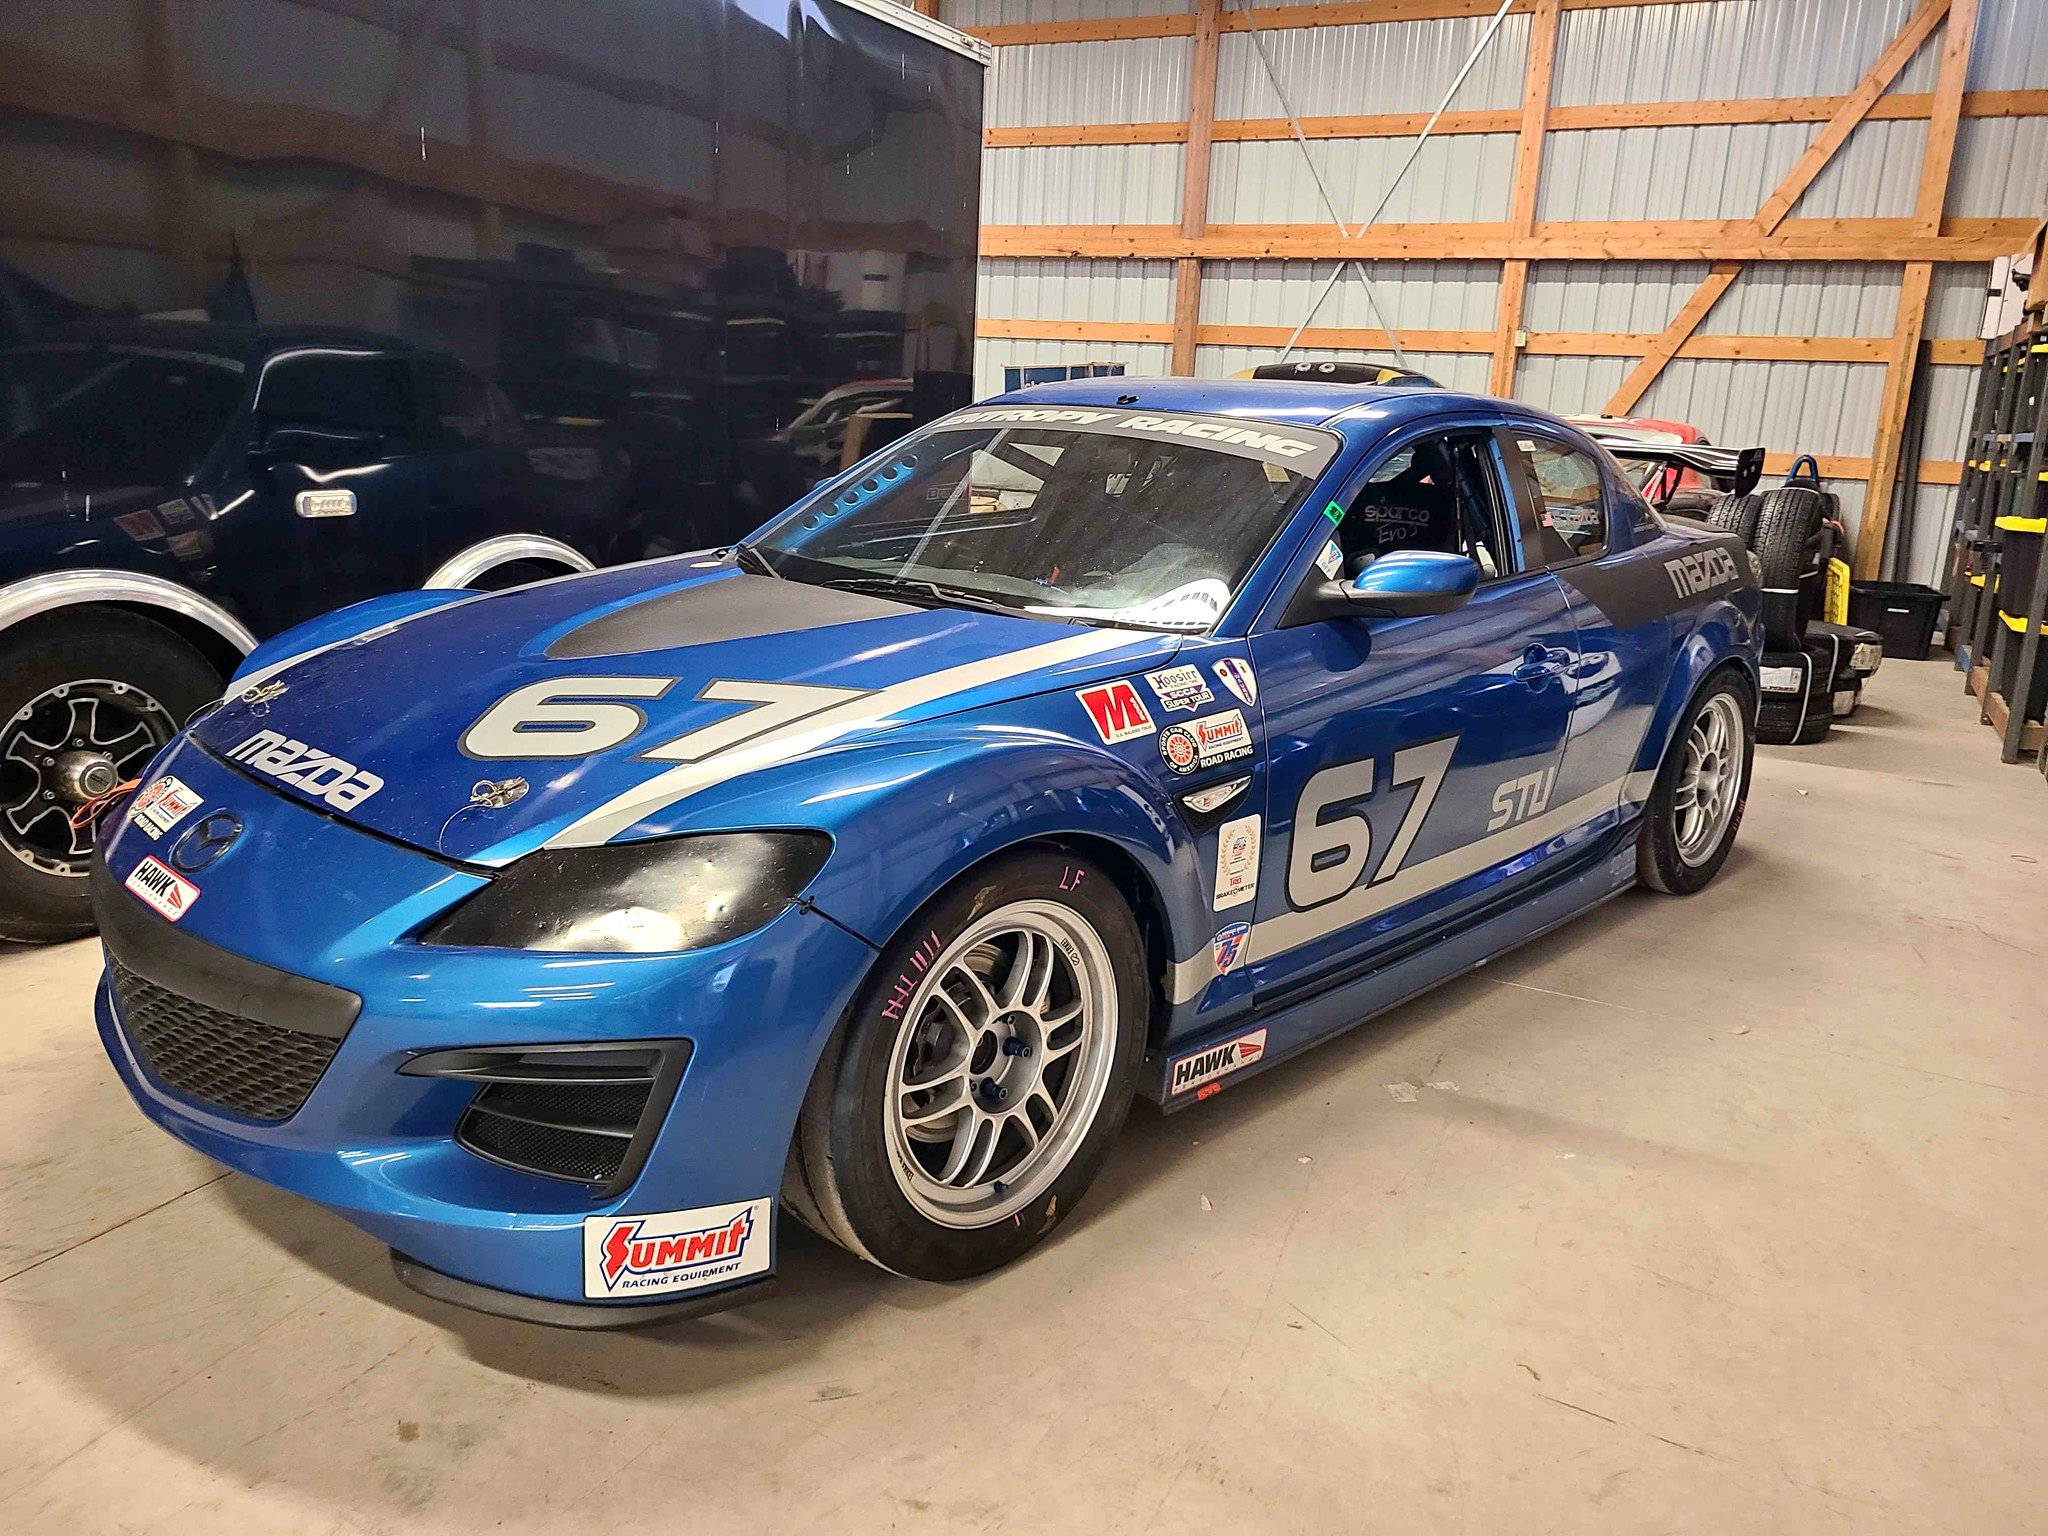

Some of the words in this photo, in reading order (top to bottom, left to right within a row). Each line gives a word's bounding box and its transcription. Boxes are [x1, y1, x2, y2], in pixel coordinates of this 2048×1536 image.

[1116, 416, 1319, 458] RACING
[1363, 504, 1430, 525] sparco
[1152, 669, 1198, 690] Hoosier
[1169, 686, 1198, 699] SCCA
[1165, 697, 1191, 708] SUPER
[1191, 692, 1211, 702] TOUR
[457, 675, 885, 764] 67
[1161, 730, 1171, 756] SPORTS
[1183, 731, 1198, 748] CLUB
[1169, 761, 1178, 769] OF
[1178, 755, 1199, 772] AMERICA
[1200, 755, 1224, 769] ROAD
[1224, 745, 1254, 760] RACING
[1284, 734, 1461, 913] 67
[134, 860, 176, 898] HAWK
[1058, 865, 1086, 892] LF
[1175, 1043, 1238, 1087] HAWK
[621, 1276, 668, 1289] RACING
[672, 1262, 742, 1283] EQUIPMENT
